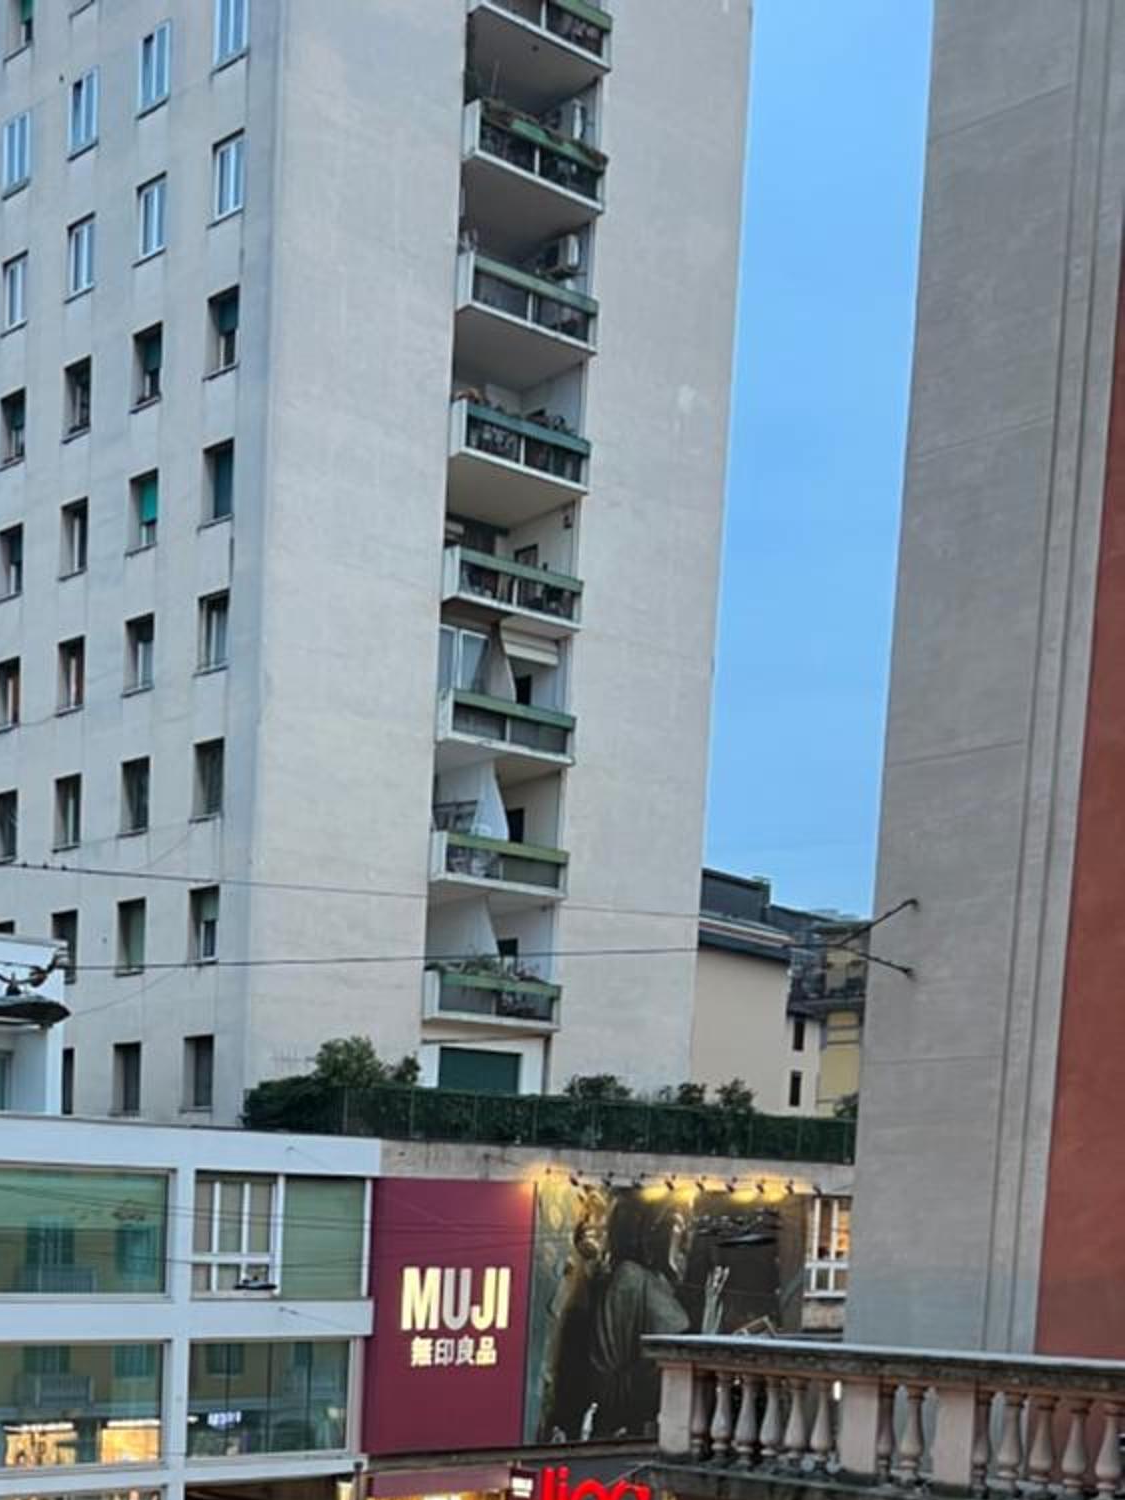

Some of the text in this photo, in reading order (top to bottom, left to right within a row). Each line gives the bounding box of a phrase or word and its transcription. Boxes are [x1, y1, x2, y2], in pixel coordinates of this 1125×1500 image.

[401, 1267, 510, 1330] MUJI
[411, 1335, 496, 1366] 無印良品
